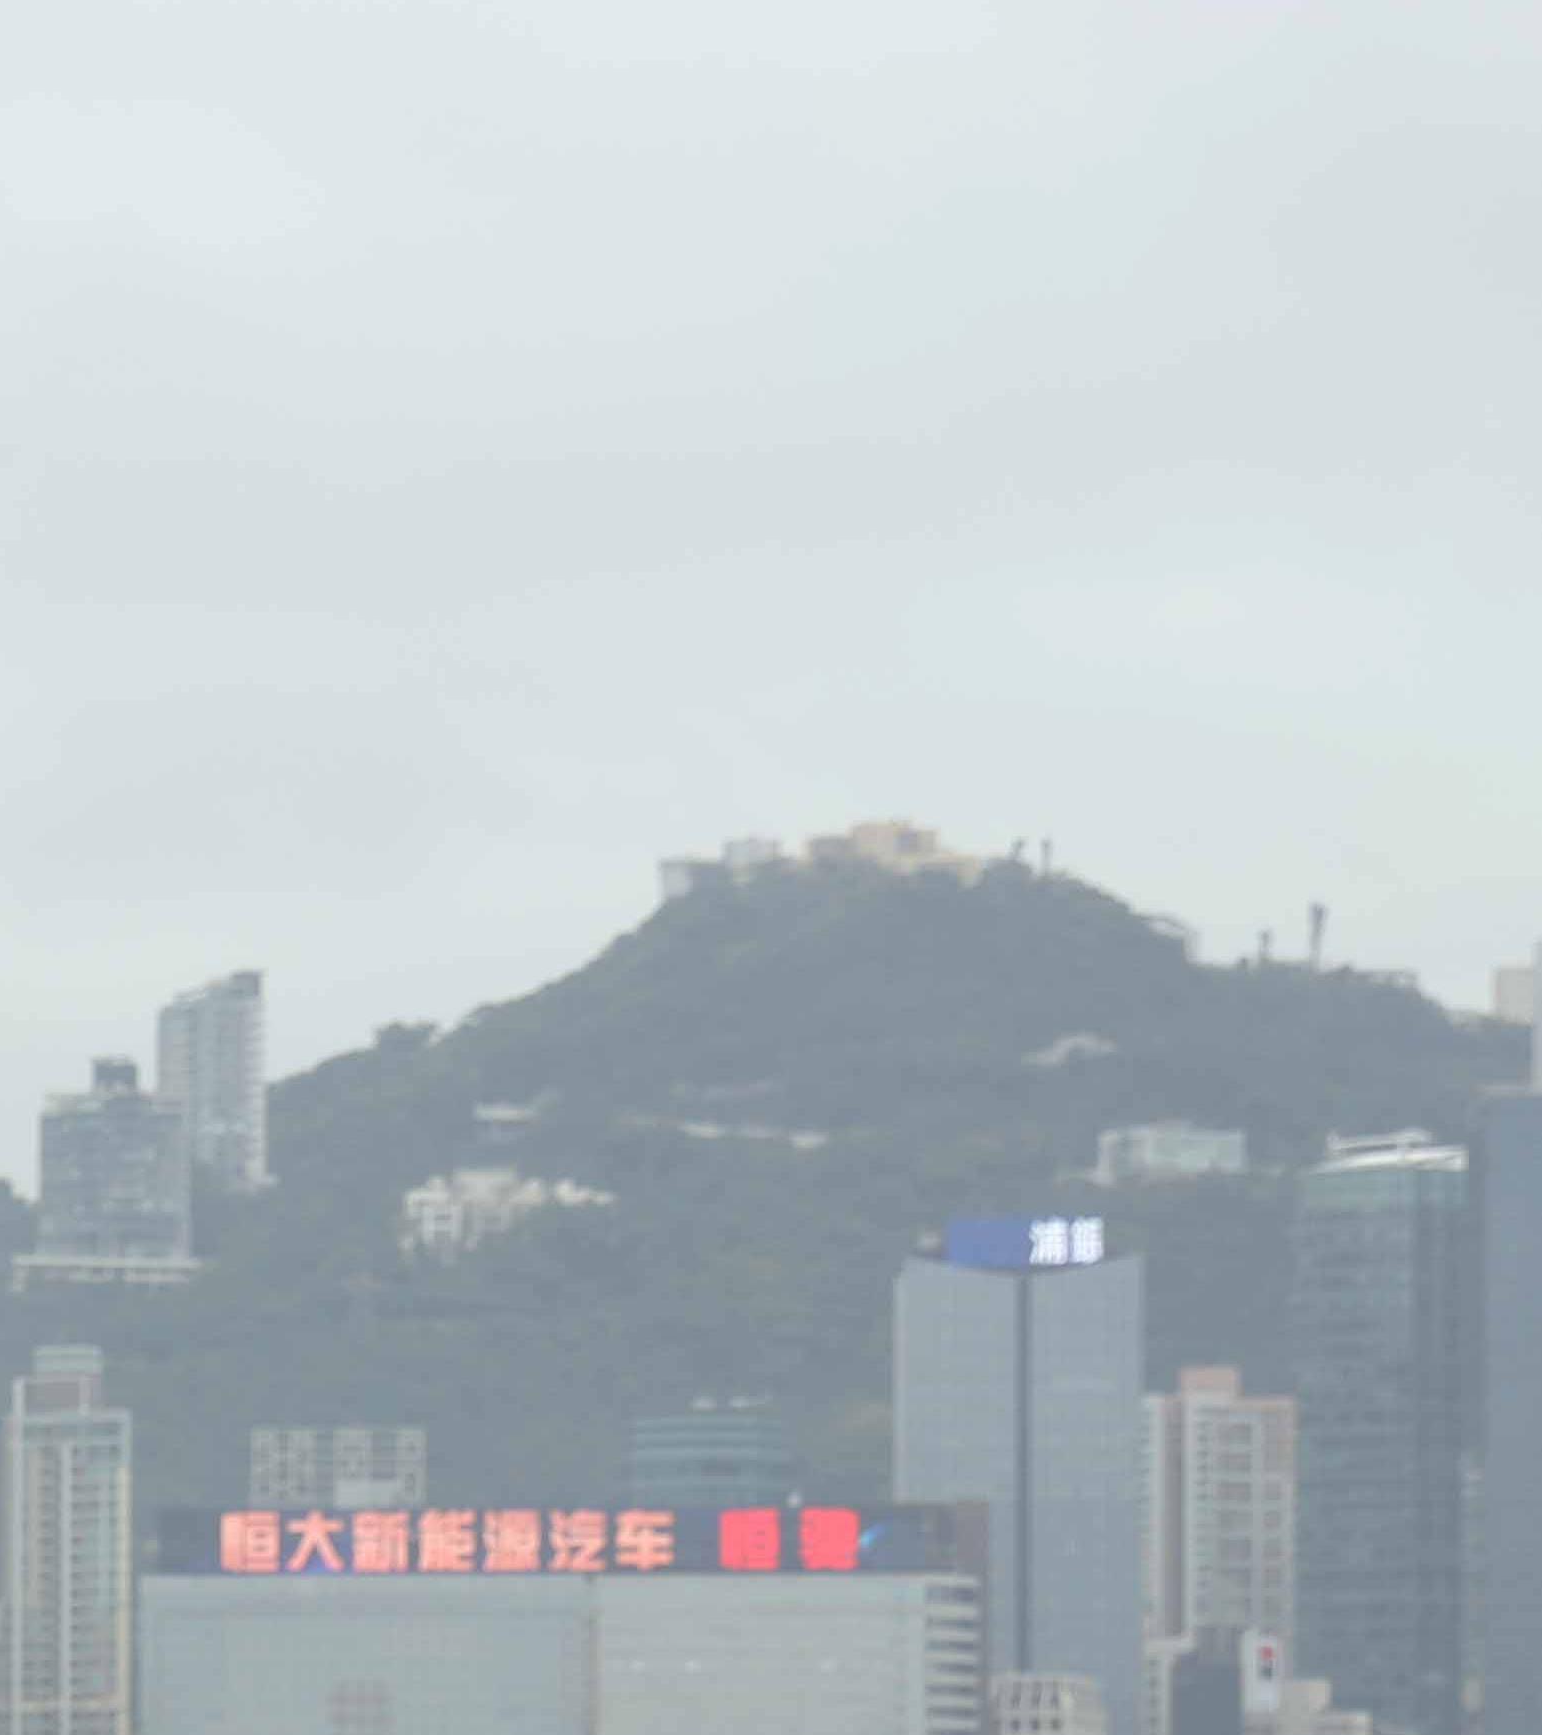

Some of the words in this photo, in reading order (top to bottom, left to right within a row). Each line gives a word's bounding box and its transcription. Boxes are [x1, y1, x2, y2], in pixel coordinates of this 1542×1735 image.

[220, 1508, 675, 1574] 恒大新能源汽车
